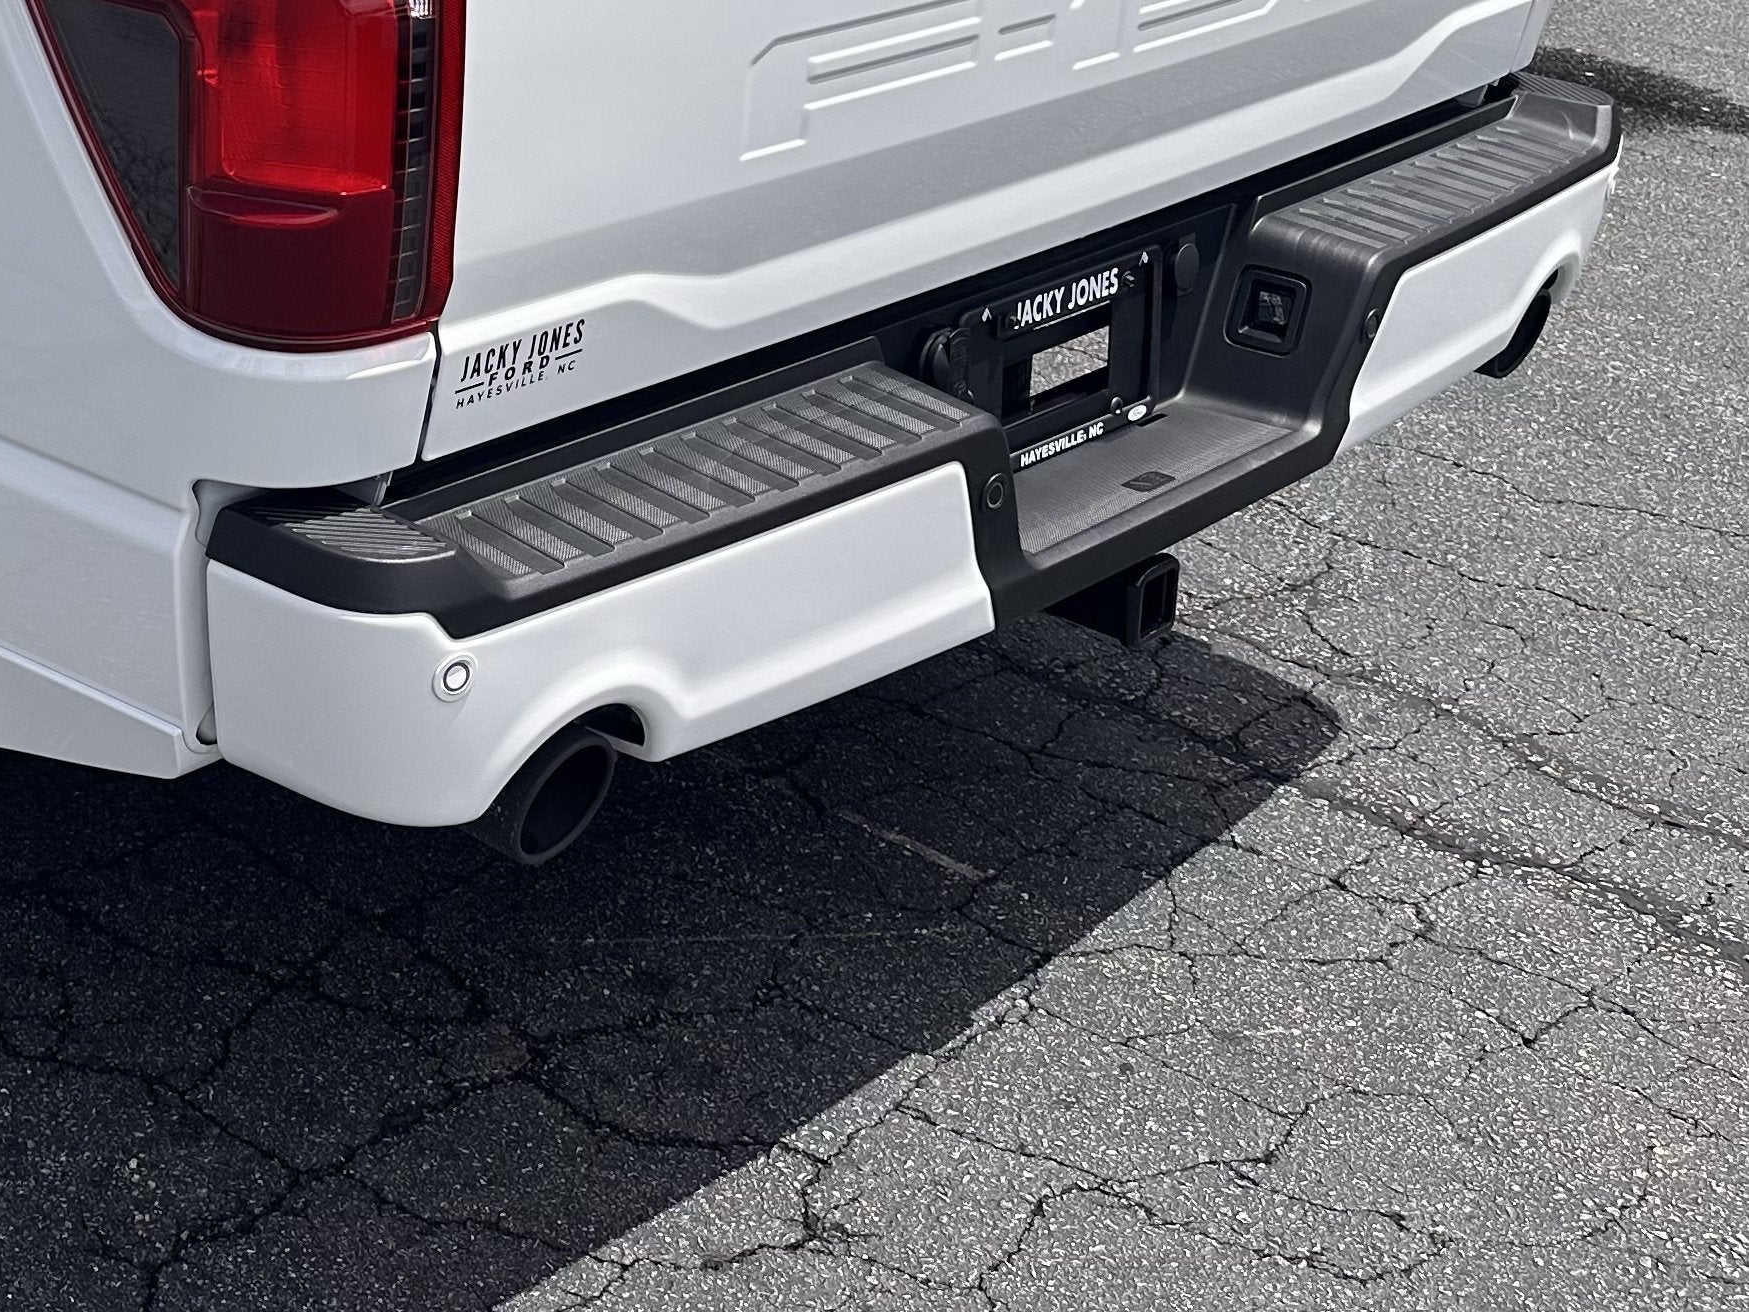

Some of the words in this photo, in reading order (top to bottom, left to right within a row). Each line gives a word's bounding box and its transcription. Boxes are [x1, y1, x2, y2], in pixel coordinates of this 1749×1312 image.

[1014, 286, 1065, 329] JACKY
[1067, 267, 1119, 310] JONES
[460, 339, 522, 382] JACKY
[528, 318, 585, 360] JONES
[488, 354, 550, 387] FORD
[557, 360, 577, 375] NC
[1088, 421, 1104, 439] NC
